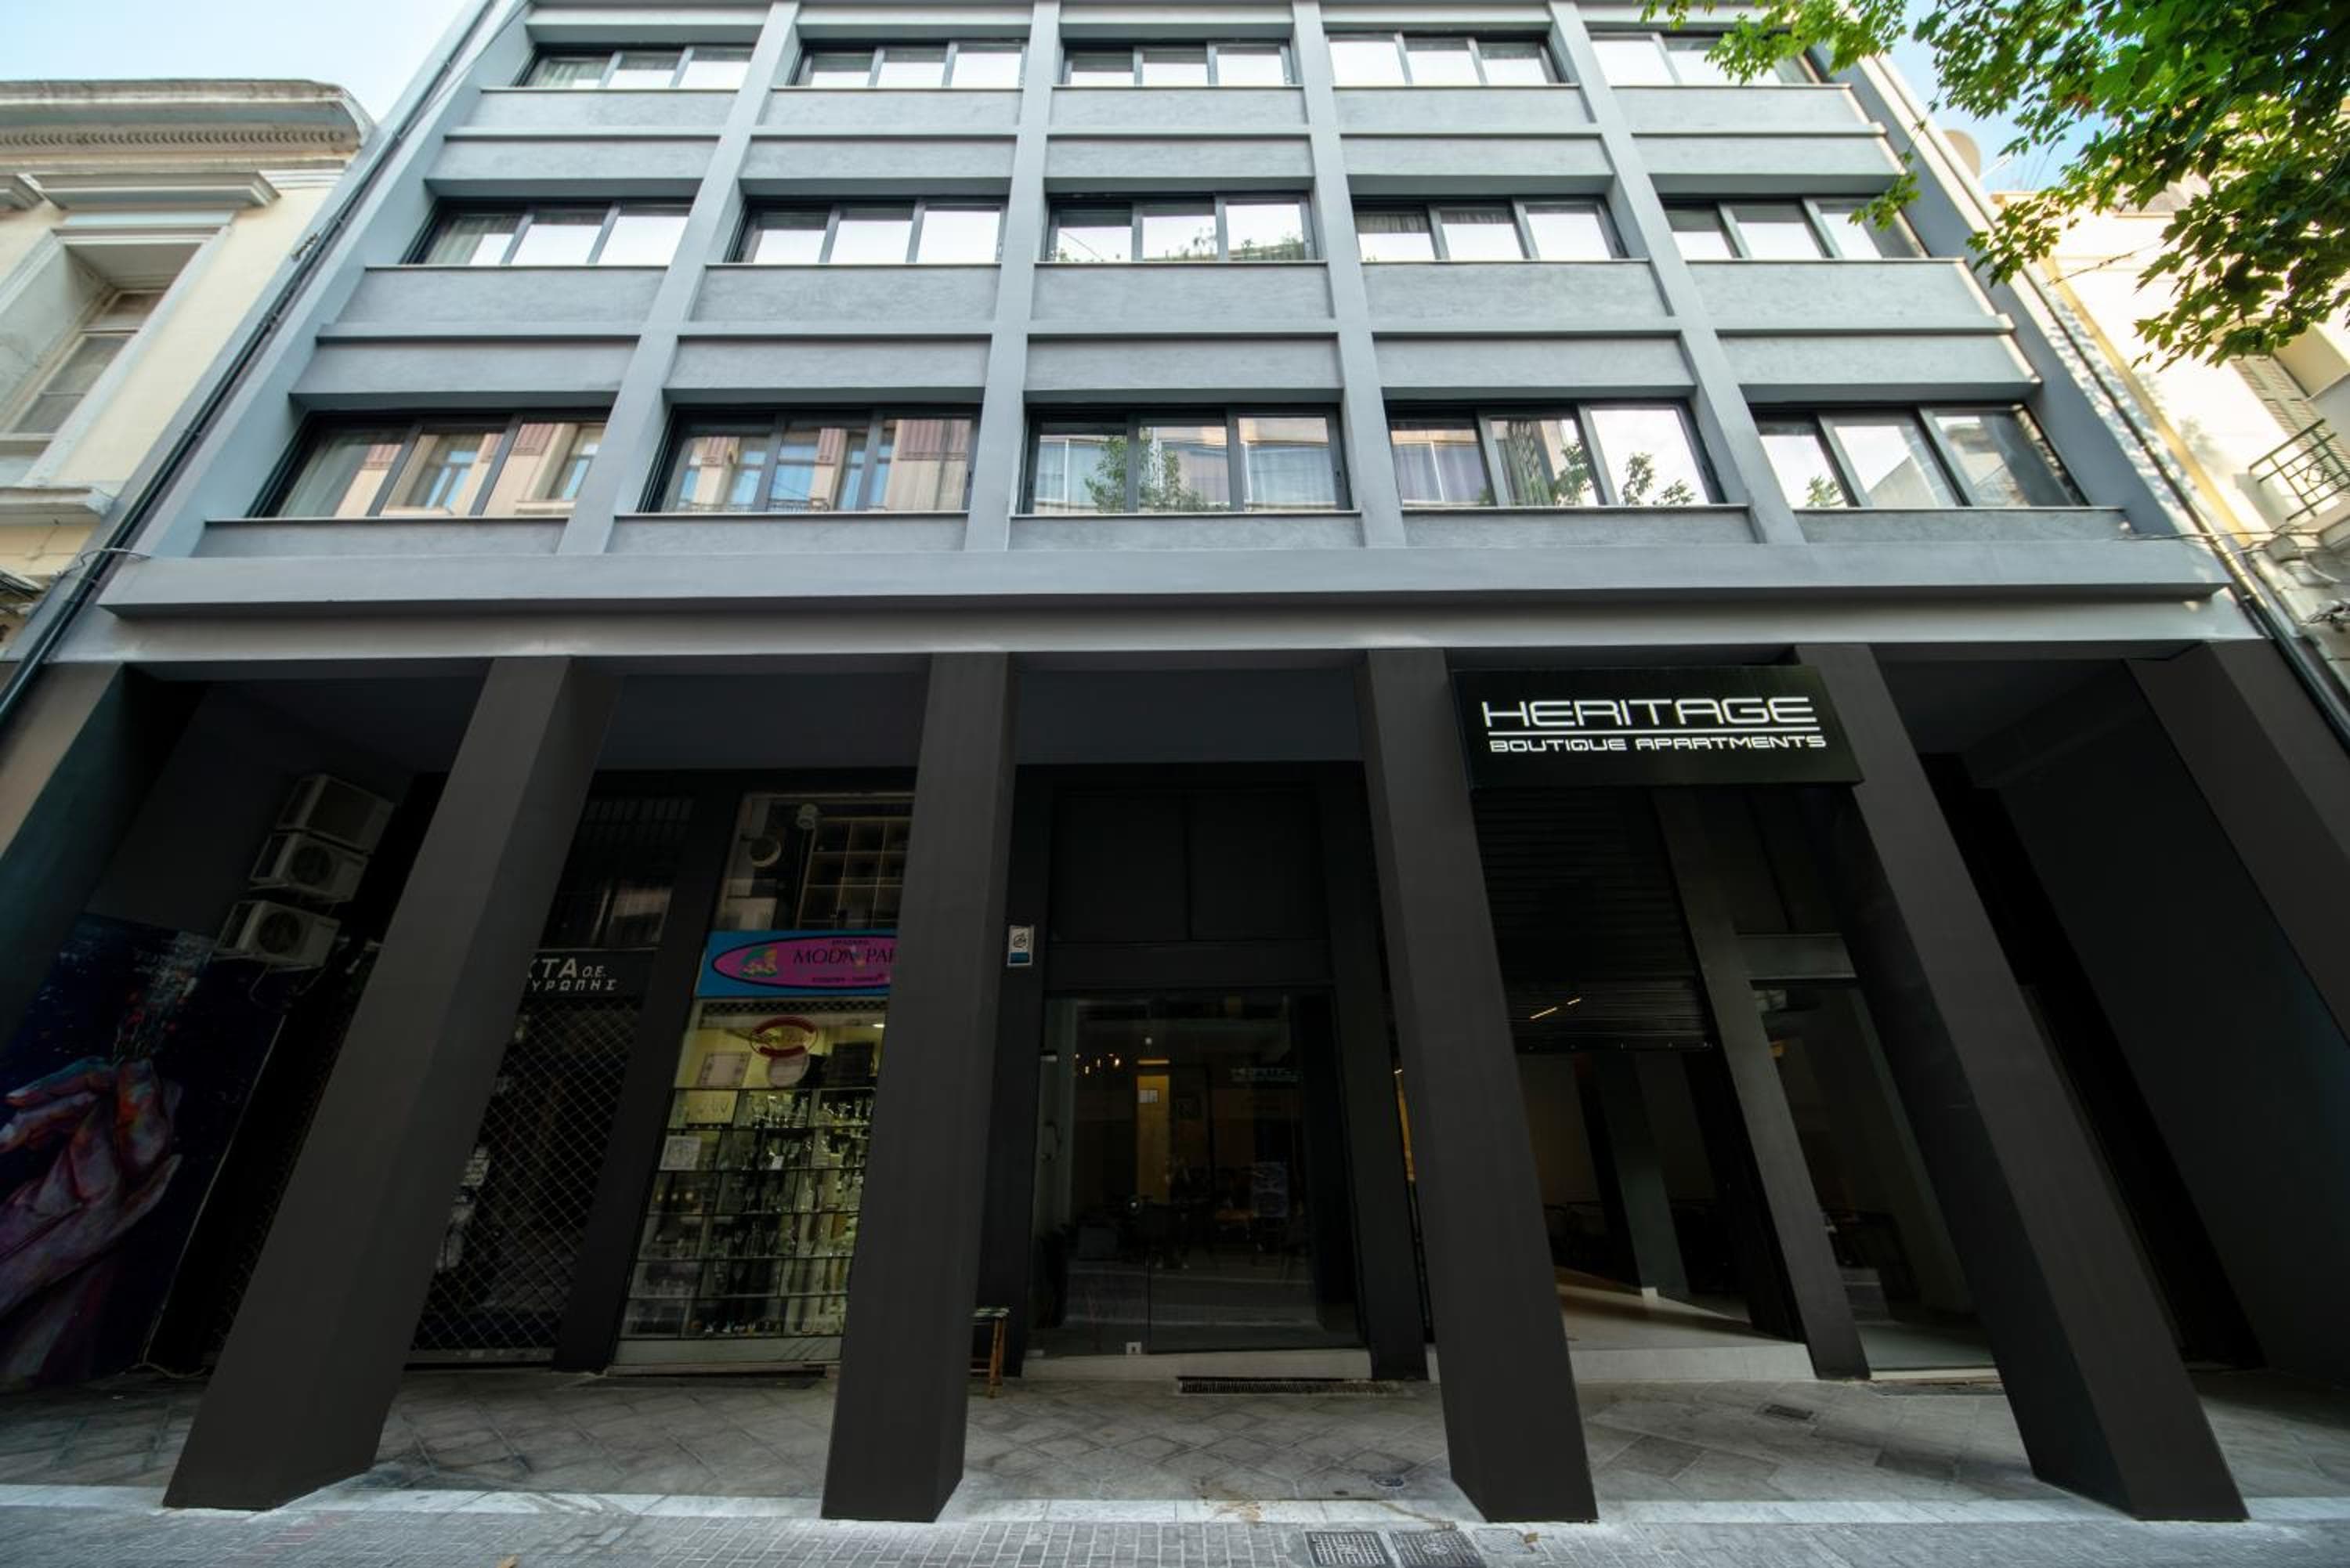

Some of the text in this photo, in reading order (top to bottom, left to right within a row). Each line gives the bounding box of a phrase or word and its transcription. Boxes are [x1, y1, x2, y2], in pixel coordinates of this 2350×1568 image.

[1481, 696, 1817, 728] HERITAGE
[1490, 735, 1827, 753] BOUTIQUE APARTMENTS
